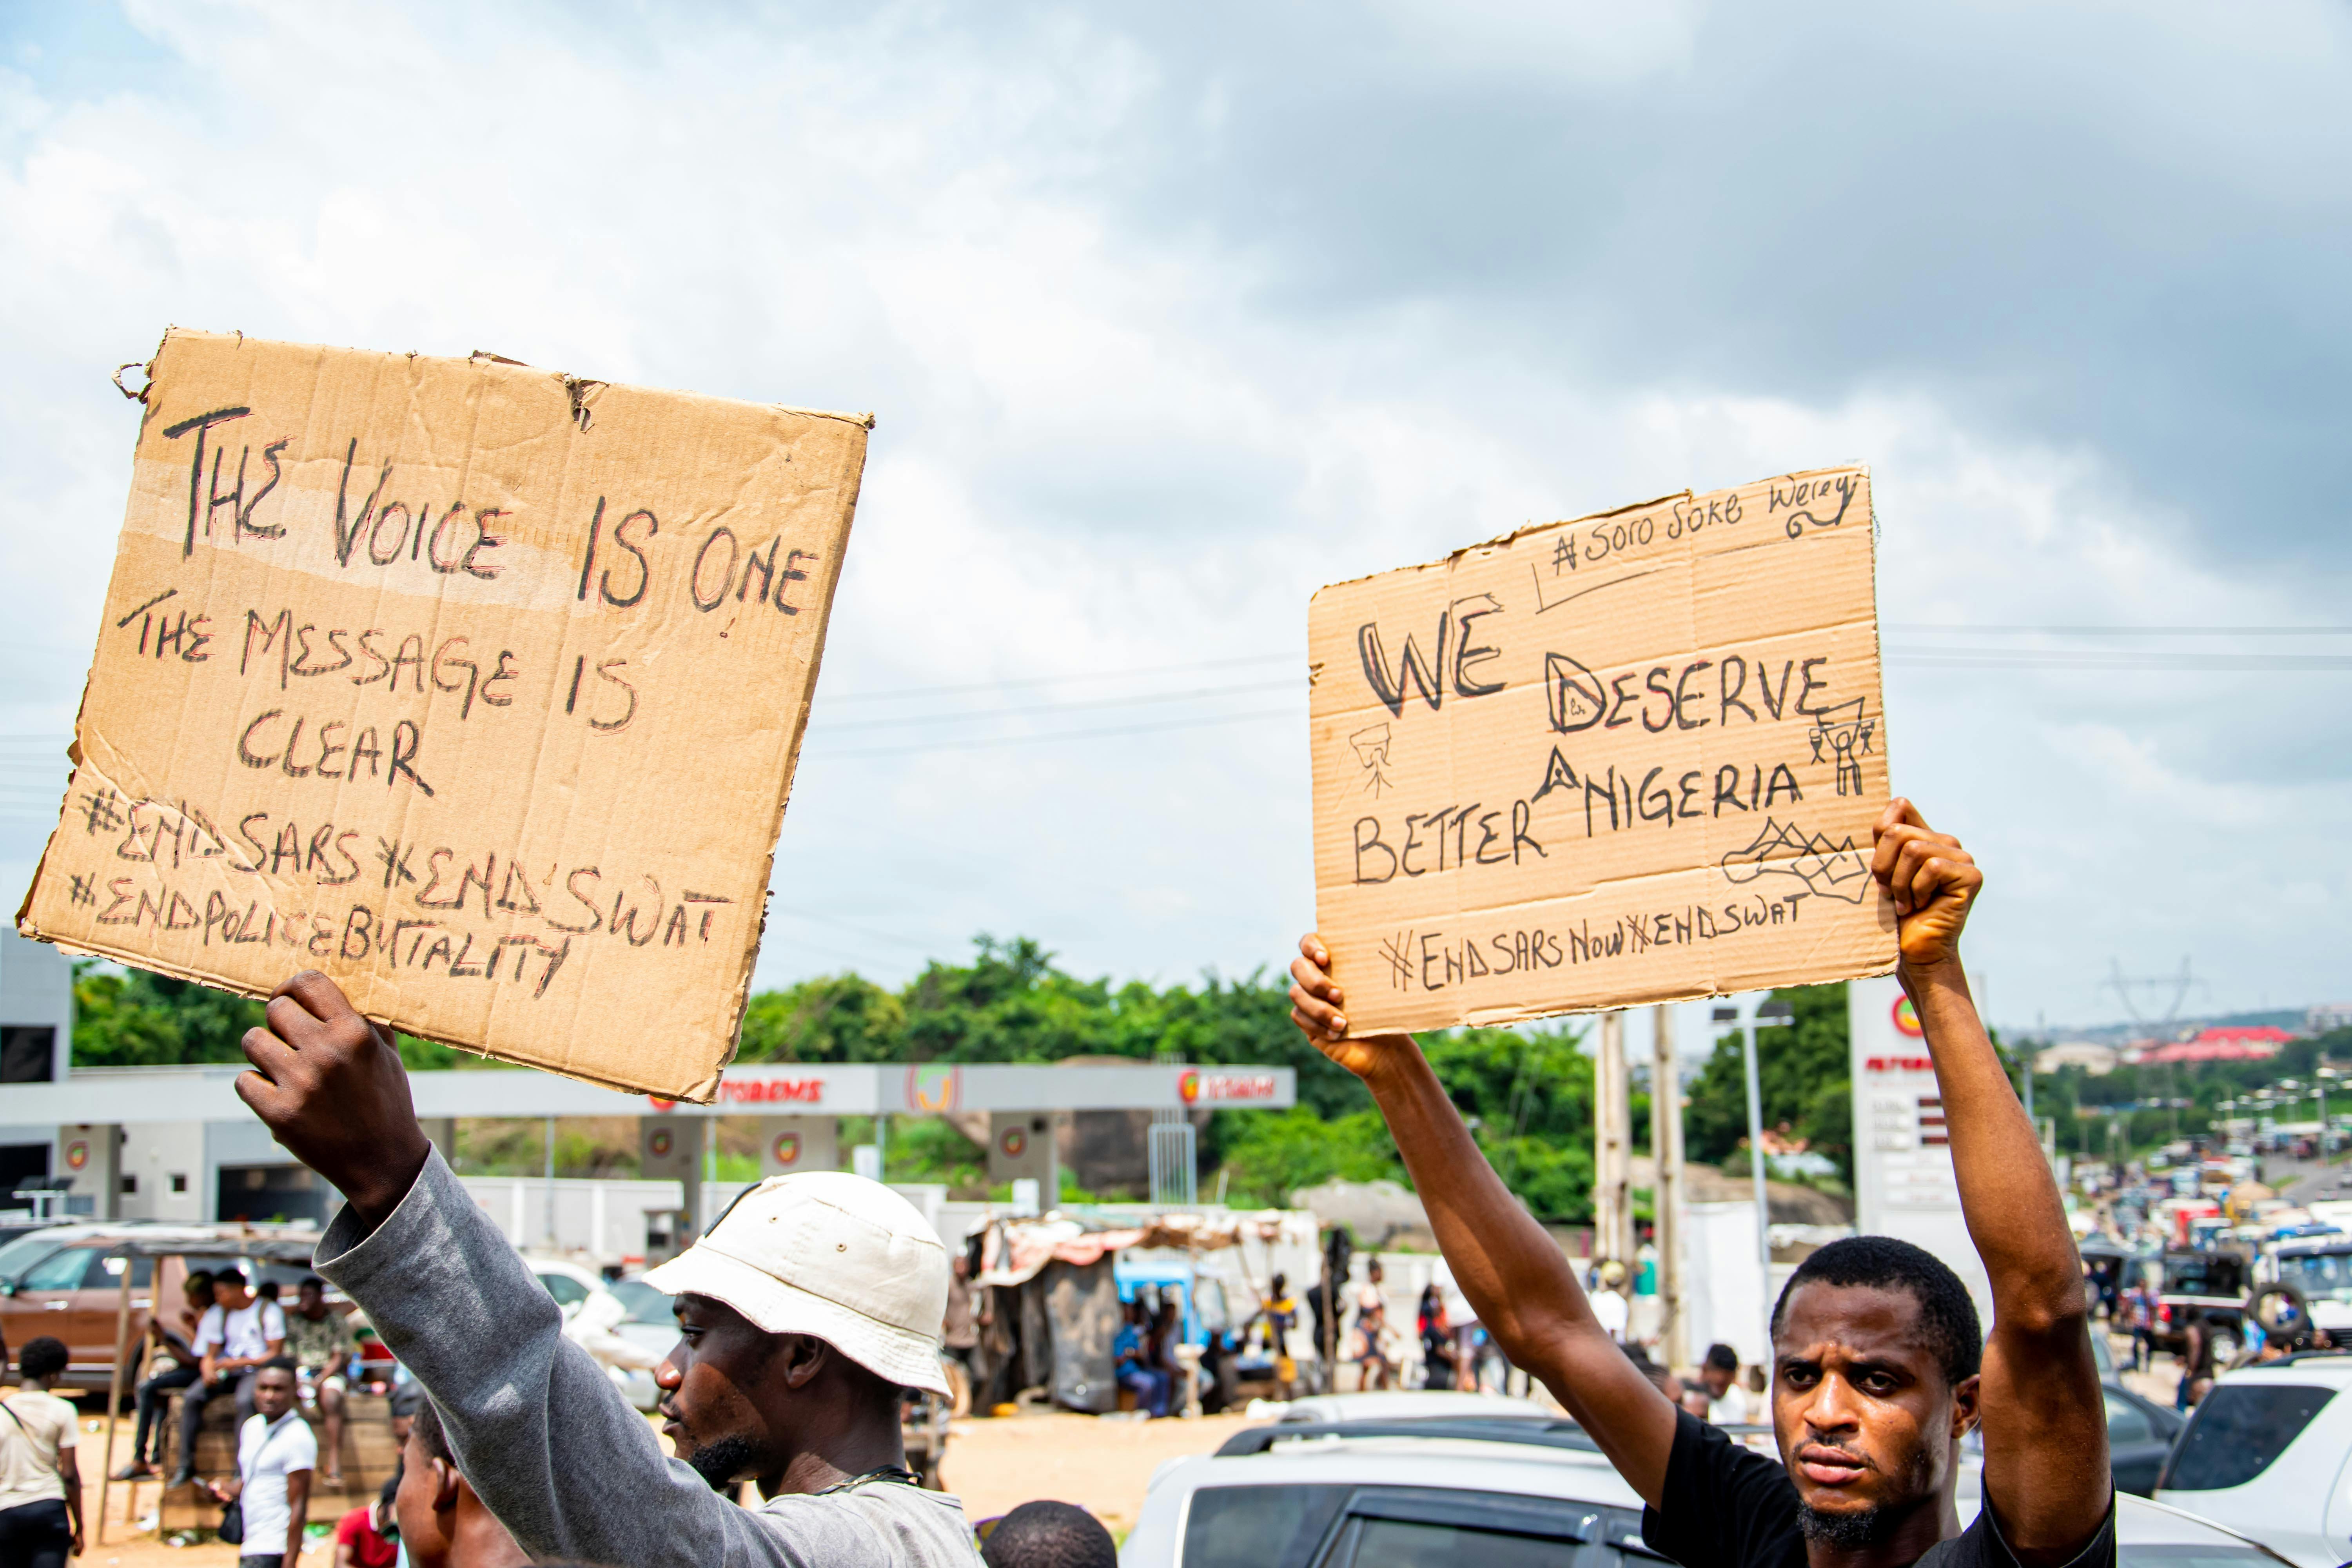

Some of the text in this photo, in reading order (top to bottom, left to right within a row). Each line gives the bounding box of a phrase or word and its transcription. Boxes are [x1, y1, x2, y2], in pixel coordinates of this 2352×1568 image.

[163, 406, 819, 615] THE VOICE IS ONE
[118, 590, 640, 733] THE MESSAGE IS
[1358, 593, 1828, 734] WE DESERVE
[238, 709, 434, 797] CLEAR
[1532, 746, 1581, 804] A
[1353, 763, 1804, 886] BETTER NIGERIA
